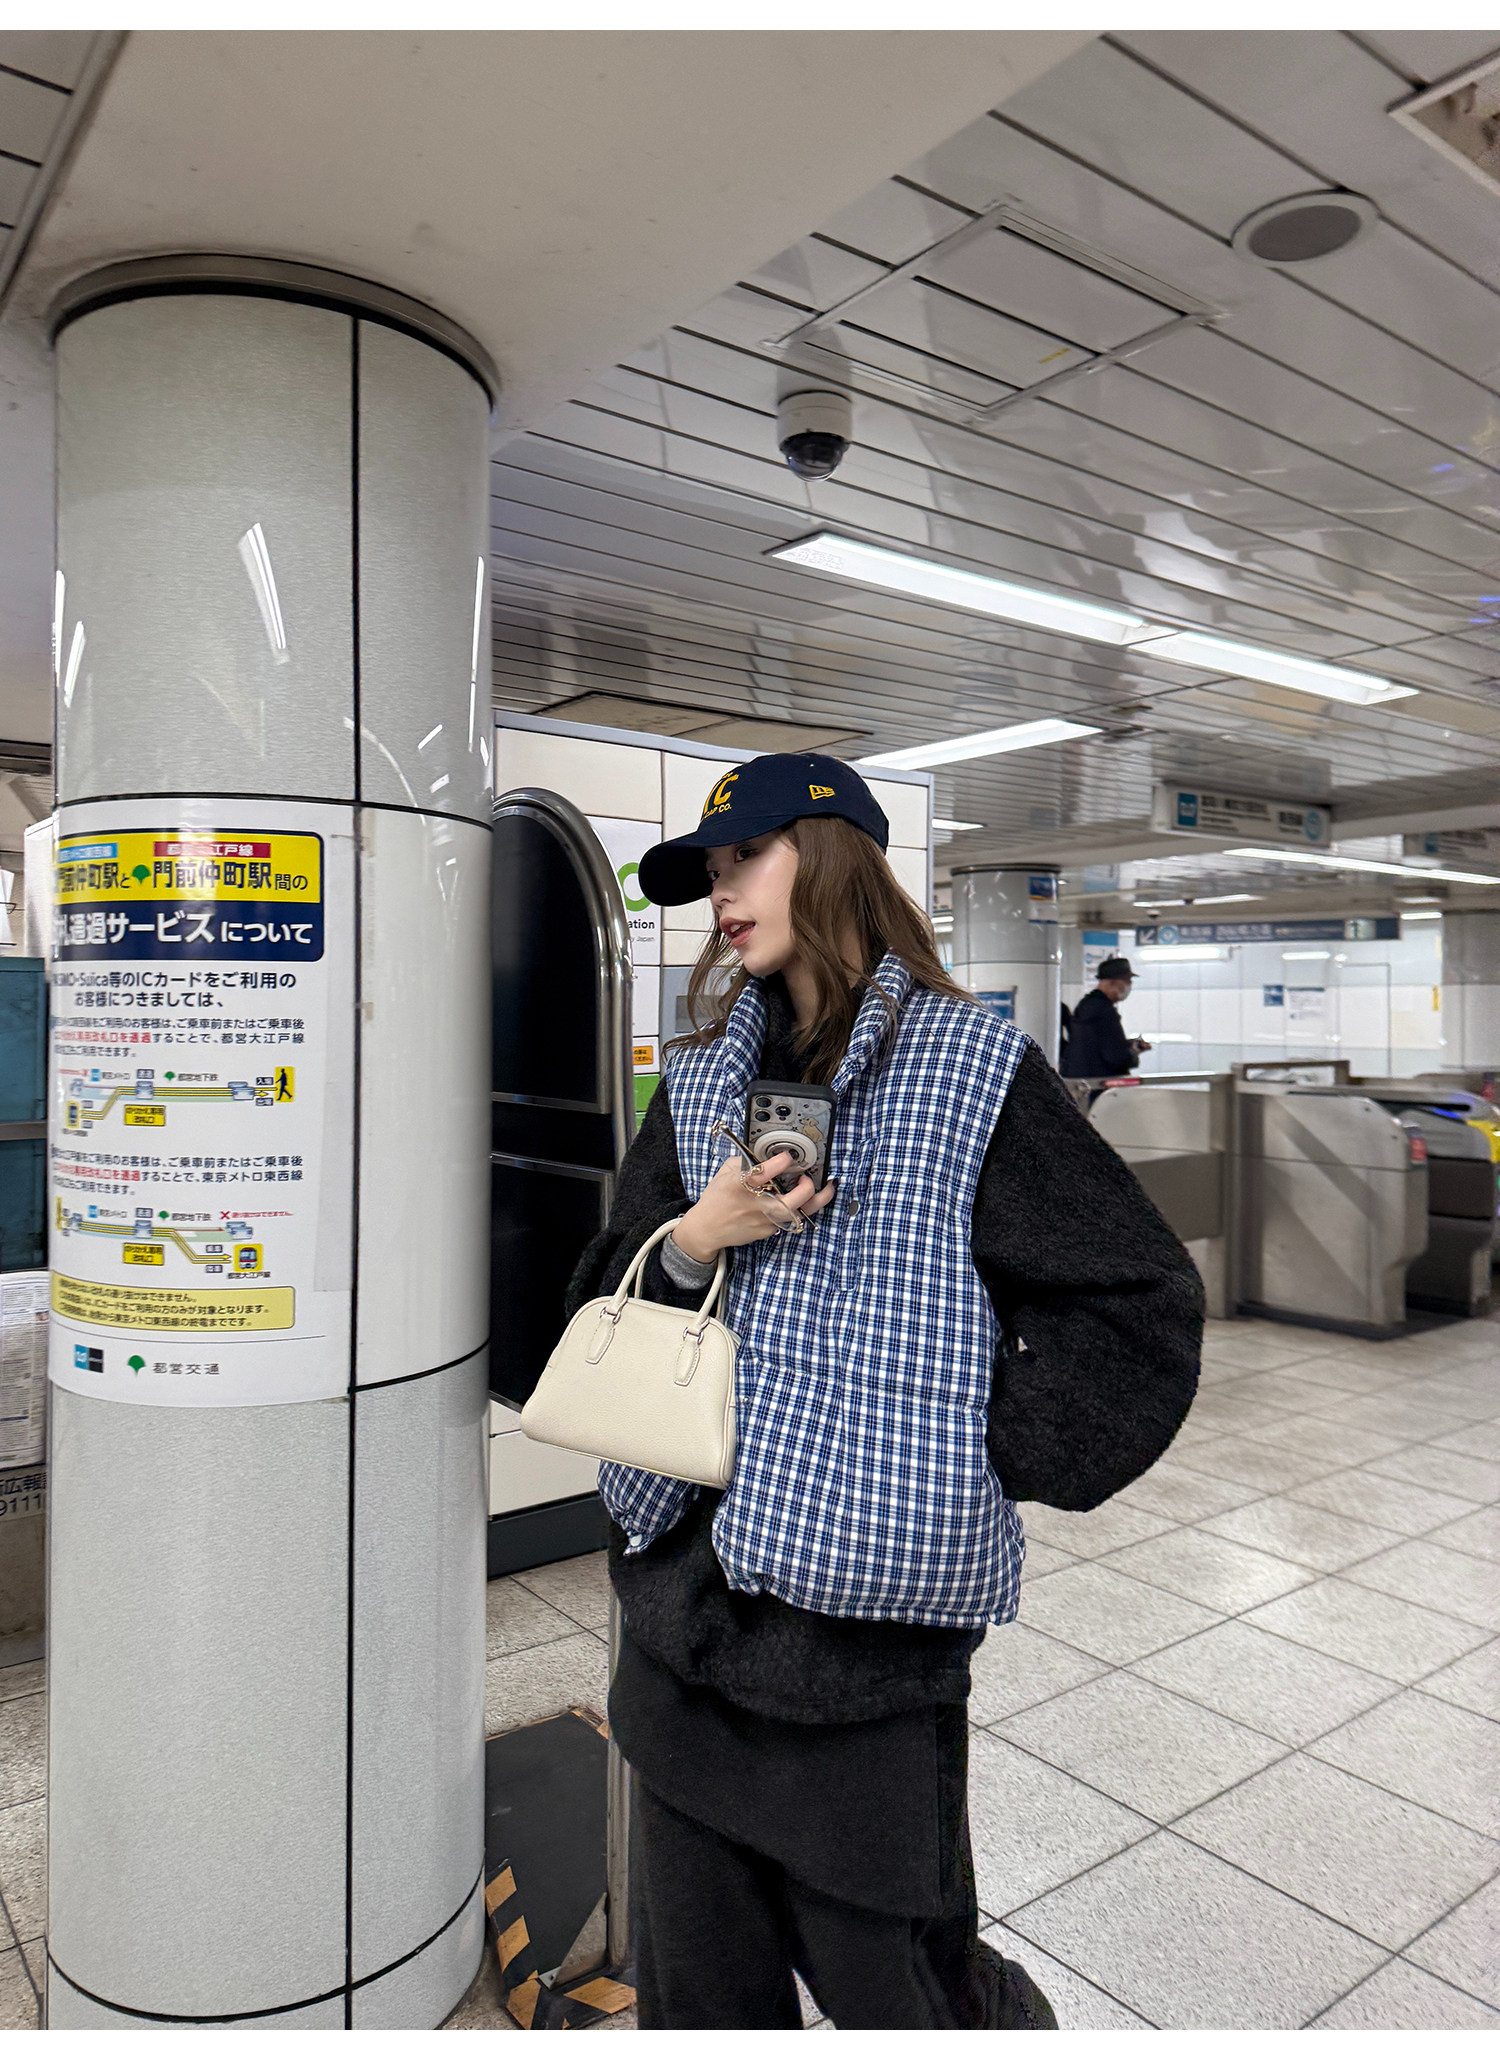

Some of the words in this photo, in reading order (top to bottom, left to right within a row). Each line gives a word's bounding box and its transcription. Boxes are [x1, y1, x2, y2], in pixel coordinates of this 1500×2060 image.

[153, 860, 309, 891] 門前仲町駅間の
[153, 1363, 220, 1375] 都営交通
